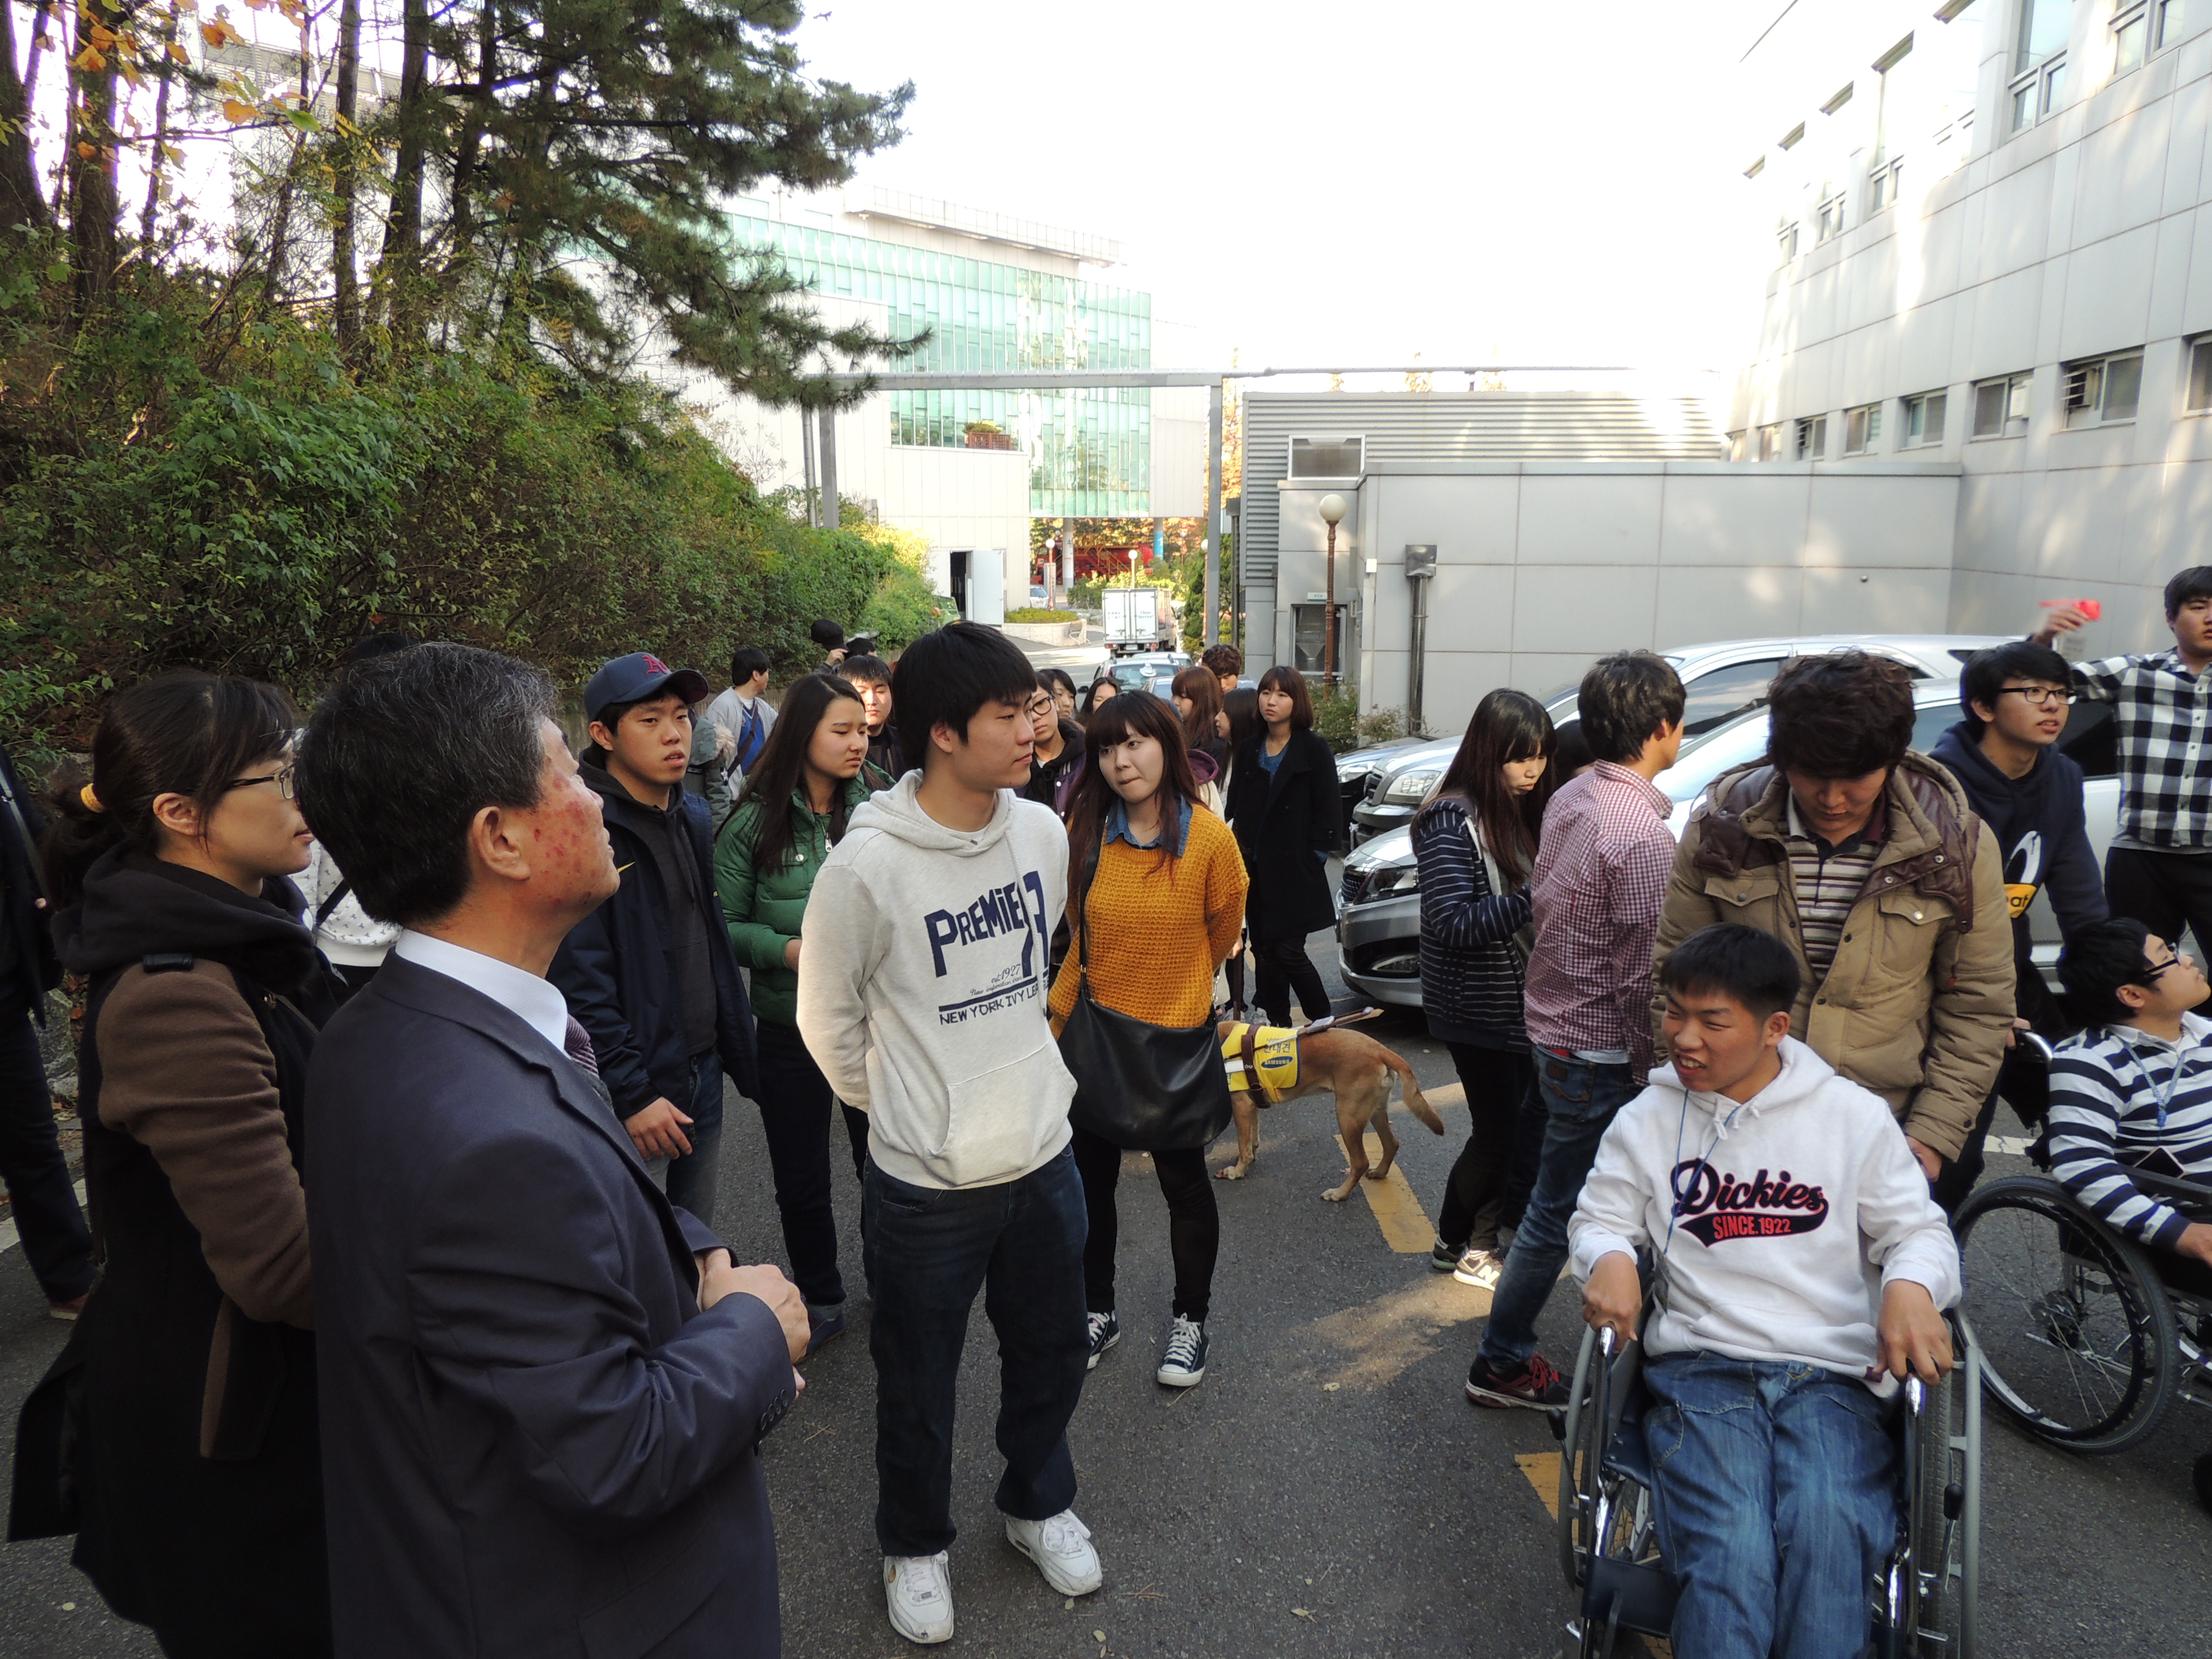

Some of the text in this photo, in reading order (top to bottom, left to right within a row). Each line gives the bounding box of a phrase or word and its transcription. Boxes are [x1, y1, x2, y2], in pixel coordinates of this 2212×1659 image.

[939, 1010, 967, 1025] NEW
[970, 999, 1004, 1018] YORK
[1006, 990, 1024, 1007] IVY
[1671, 1158, 1824, 1217] Dickies
